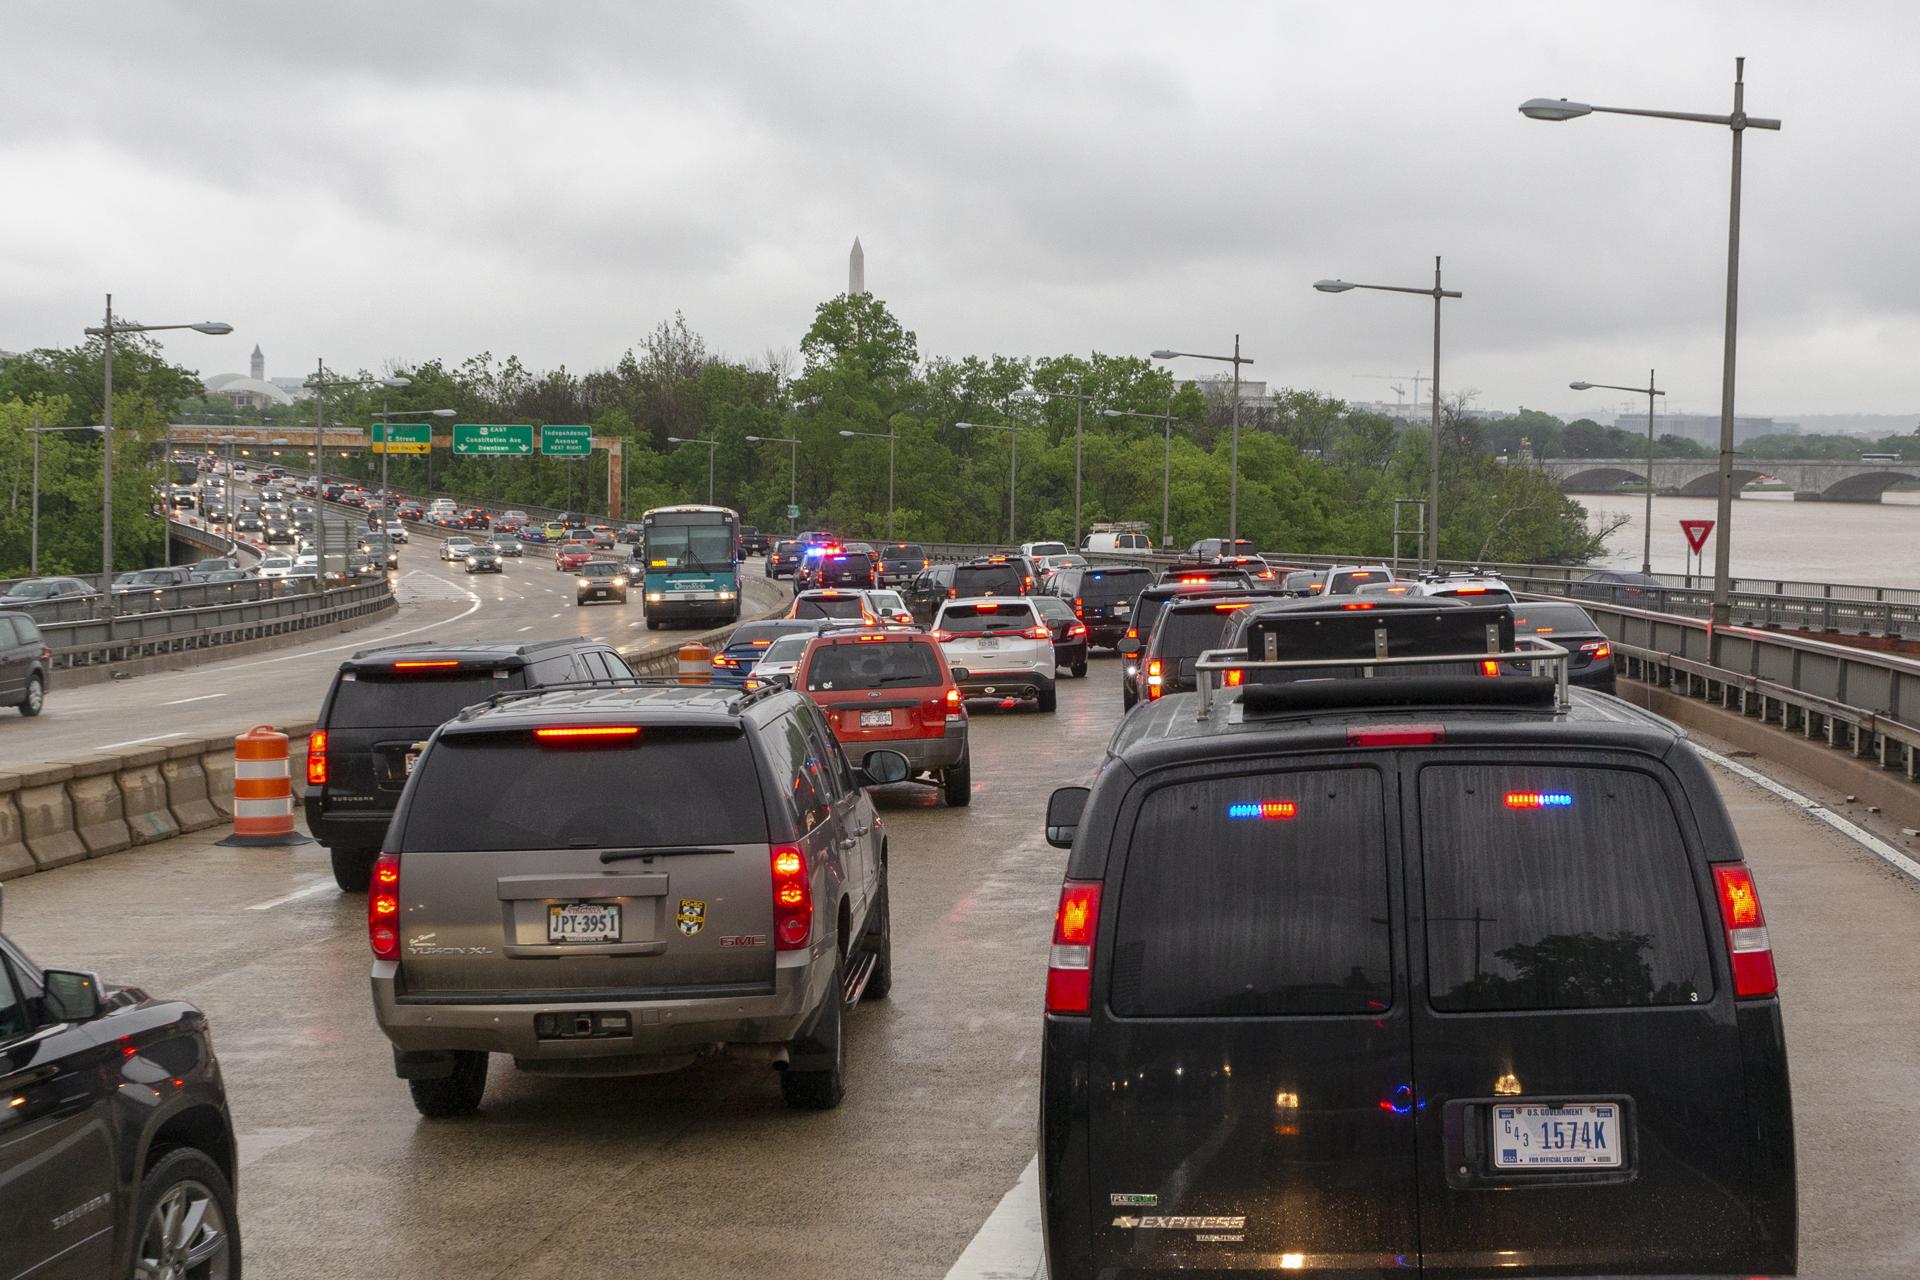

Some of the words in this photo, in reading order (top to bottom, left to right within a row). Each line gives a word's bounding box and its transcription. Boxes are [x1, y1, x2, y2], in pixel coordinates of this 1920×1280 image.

[553, 914, 616, 933] JPY-3951
[677, 914, 704, 923] UNITED
[719, 934, 767, 948] GMC
[469, 947, 494, 955] XL
[1690, 992, 1698, 1002] 3
[1541, 1121, 1606, 1149] 1574K
[1138, 1215, 1247, 1228] EXPRESS
